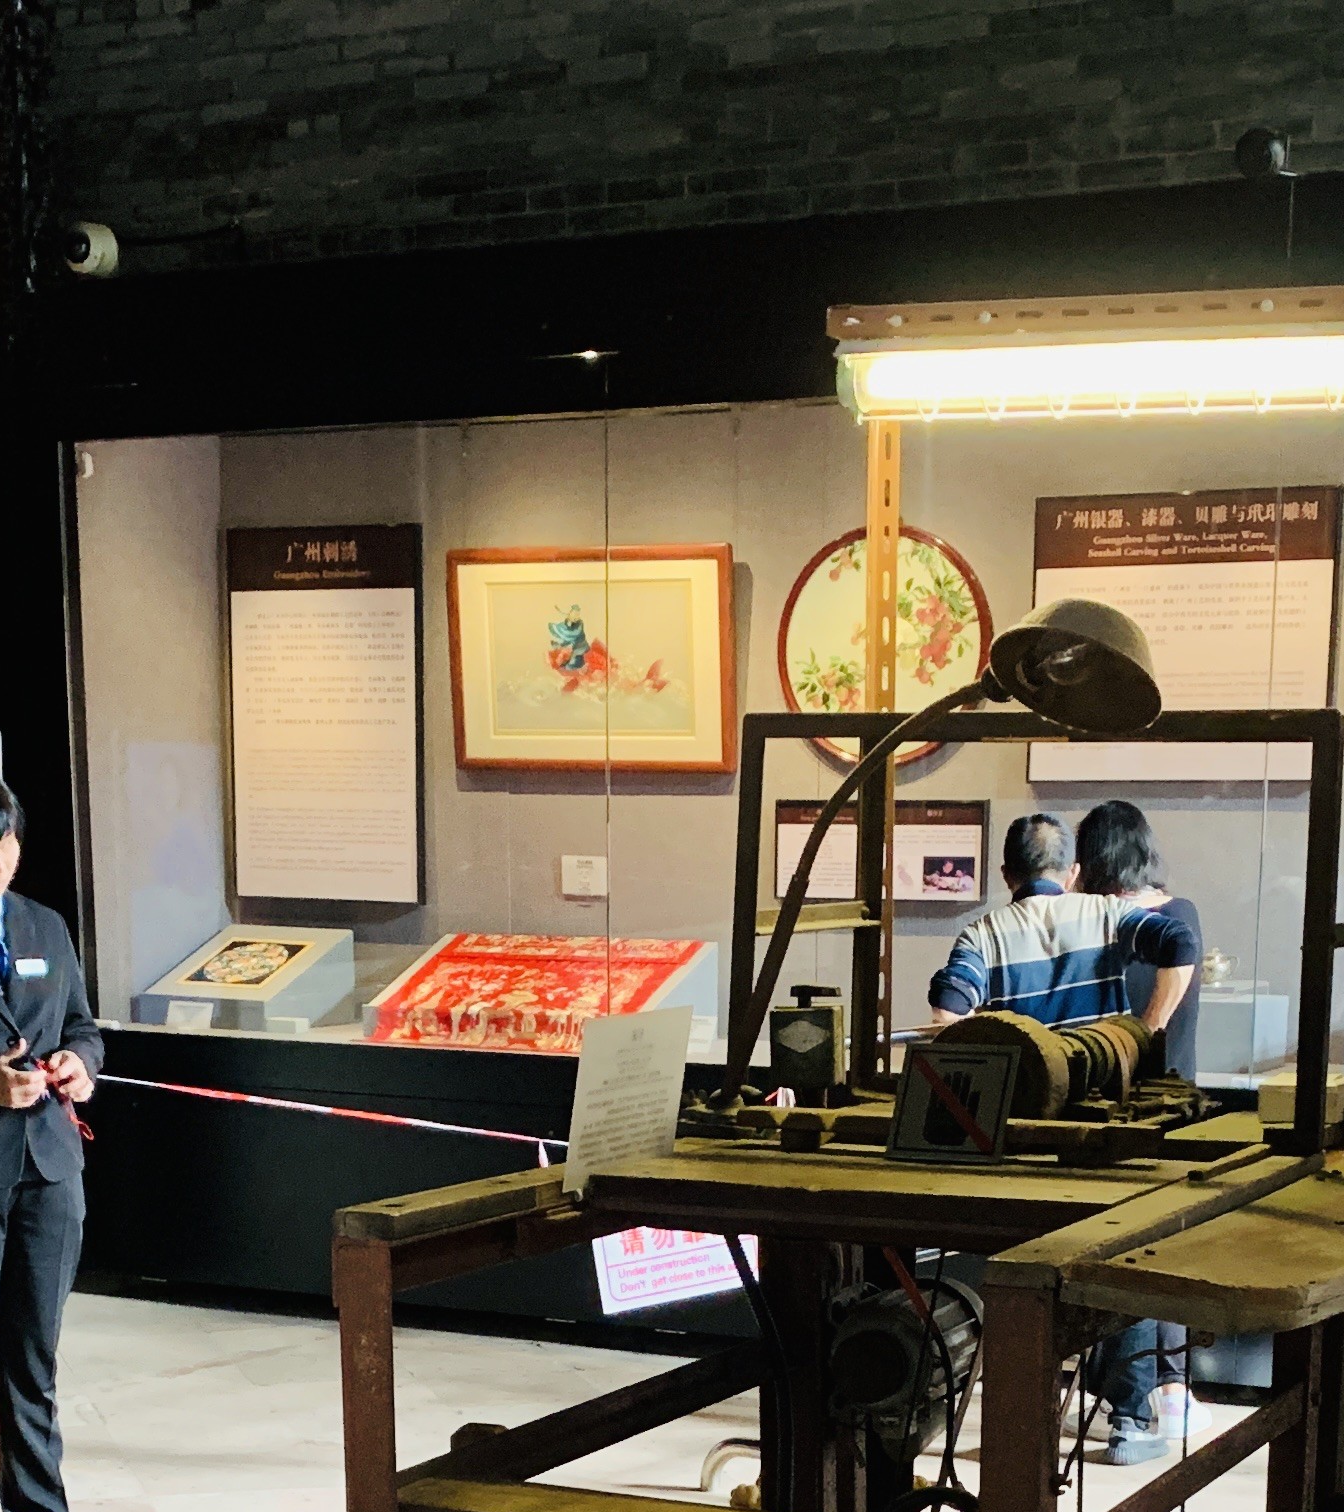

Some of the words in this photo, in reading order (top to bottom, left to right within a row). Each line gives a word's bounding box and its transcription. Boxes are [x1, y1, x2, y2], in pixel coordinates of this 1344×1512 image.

[1092, 534, 1143, 546] Guangzhou
[1160, 546, 1178, 555] and
[618, 1265, 648, 1279] Under
[650, 1254, 710, 1273] construction
[651, 1274, 667, 1289] get
[669, 1270, 695, 1283] close
[696, 1268, 706, 1278] to
[708, 1263, 725, 1275] this
